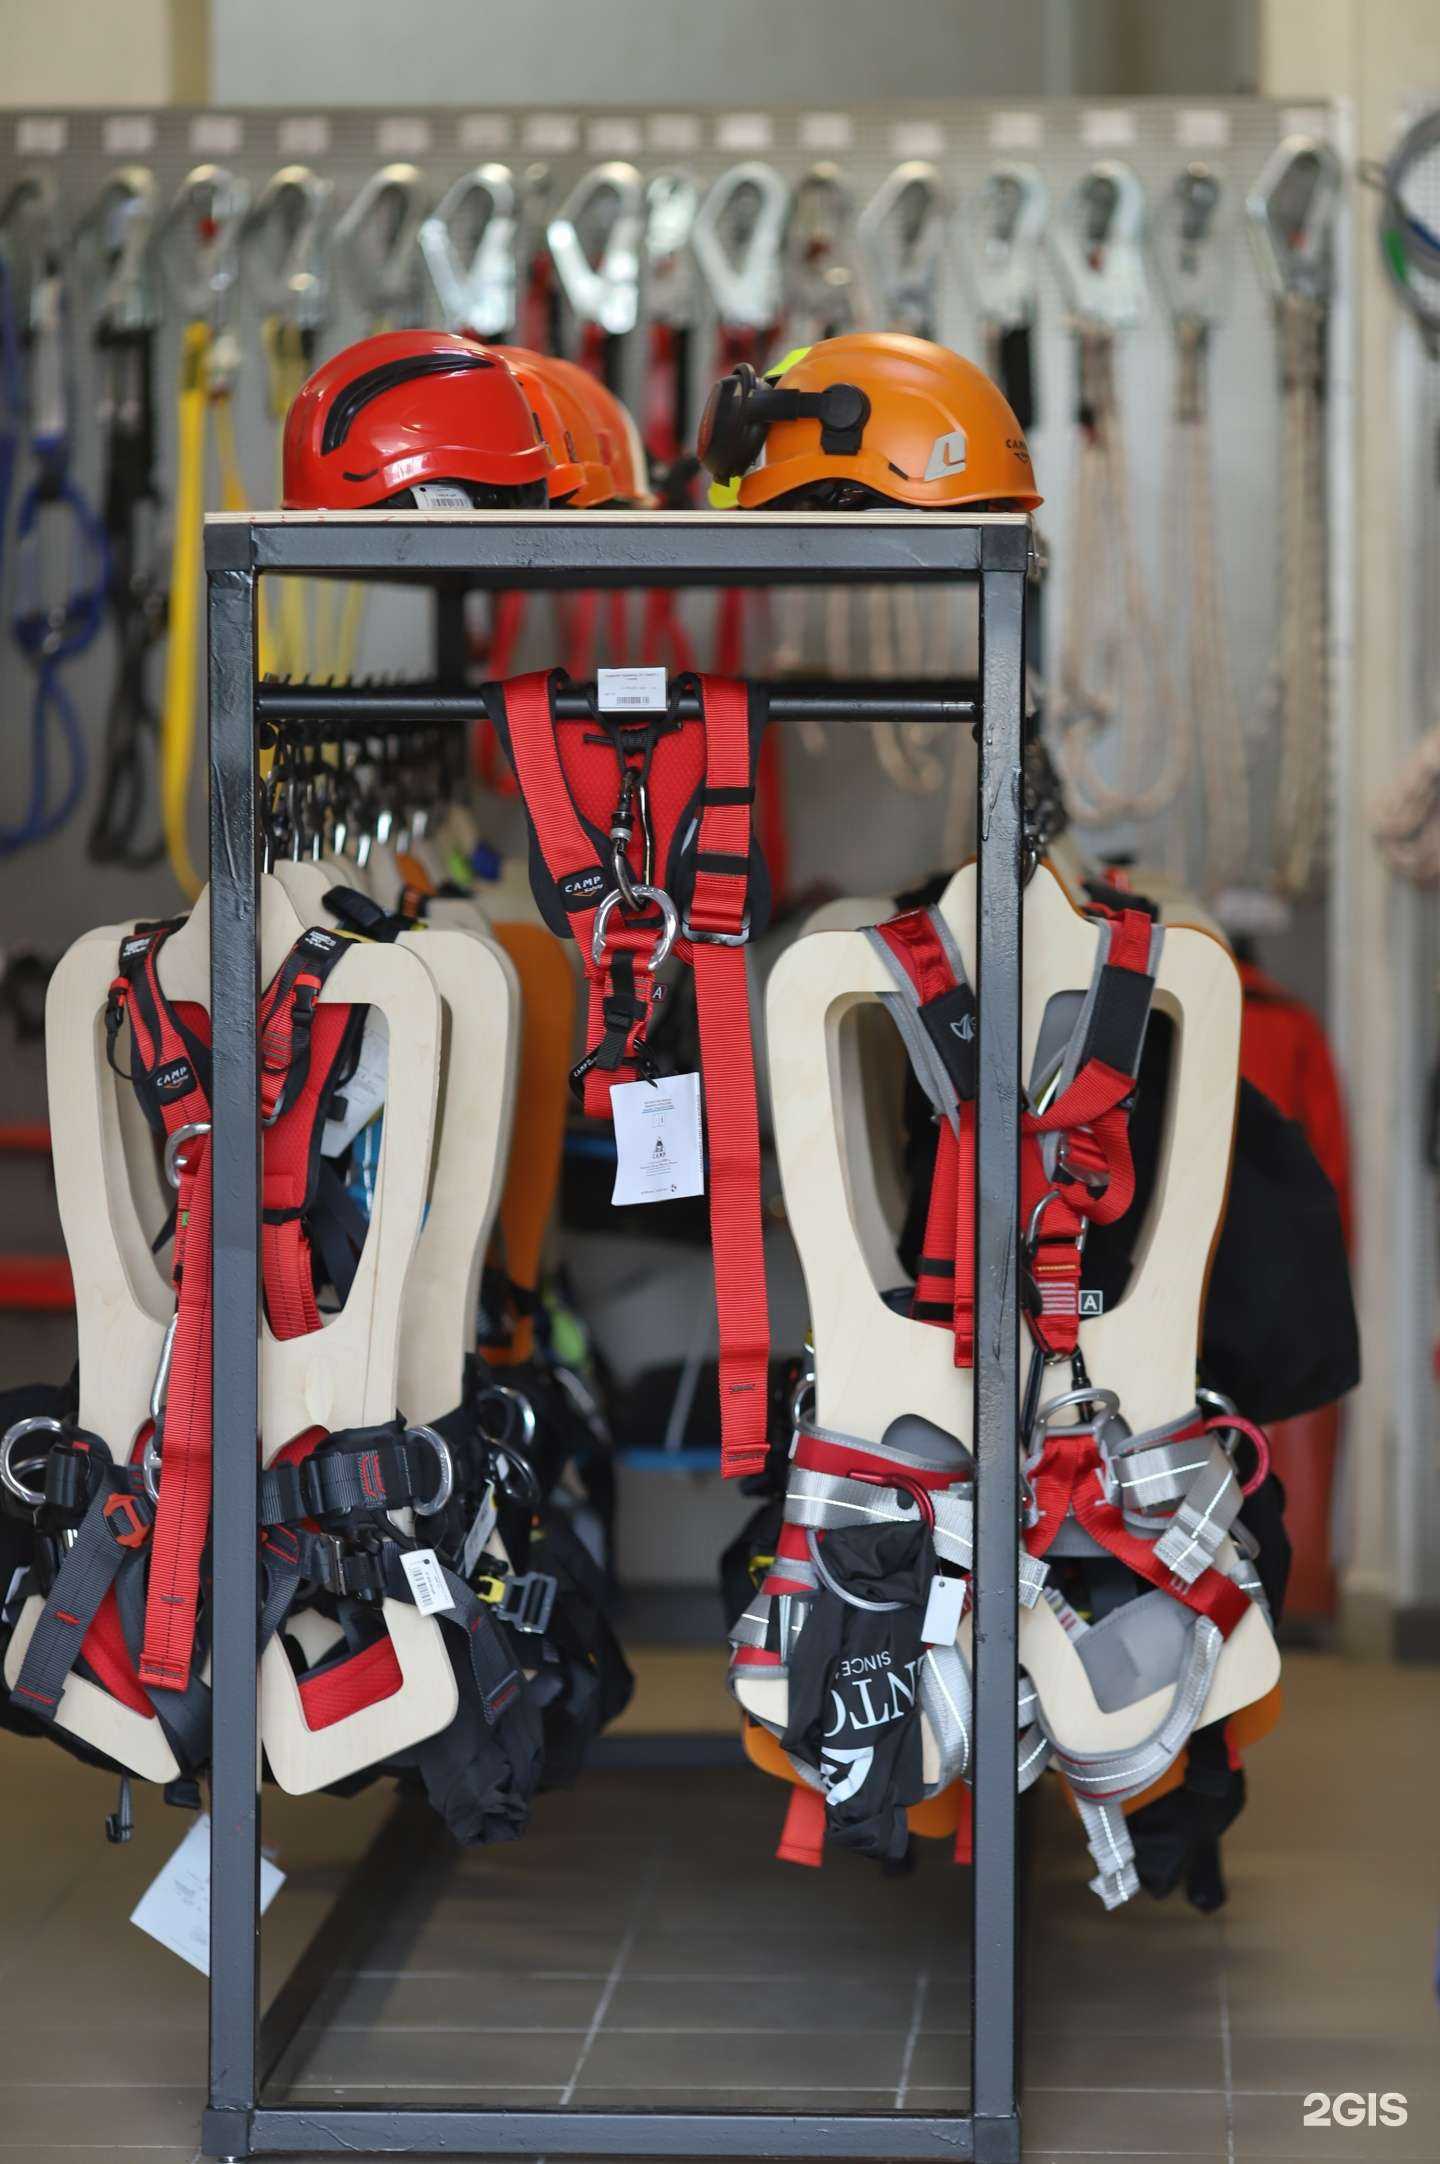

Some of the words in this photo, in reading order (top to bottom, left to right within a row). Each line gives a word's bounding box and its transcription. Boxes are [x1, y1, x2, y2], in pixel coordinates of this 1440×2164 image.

[565, 876, 601, 893] CAMP
[652, 986, 662, 999] A
[156, 1066, 188, 1086] CAMP
[1083, 1294, 1098, 1310] A
[841, 1650, 892, 1677] SINCE
